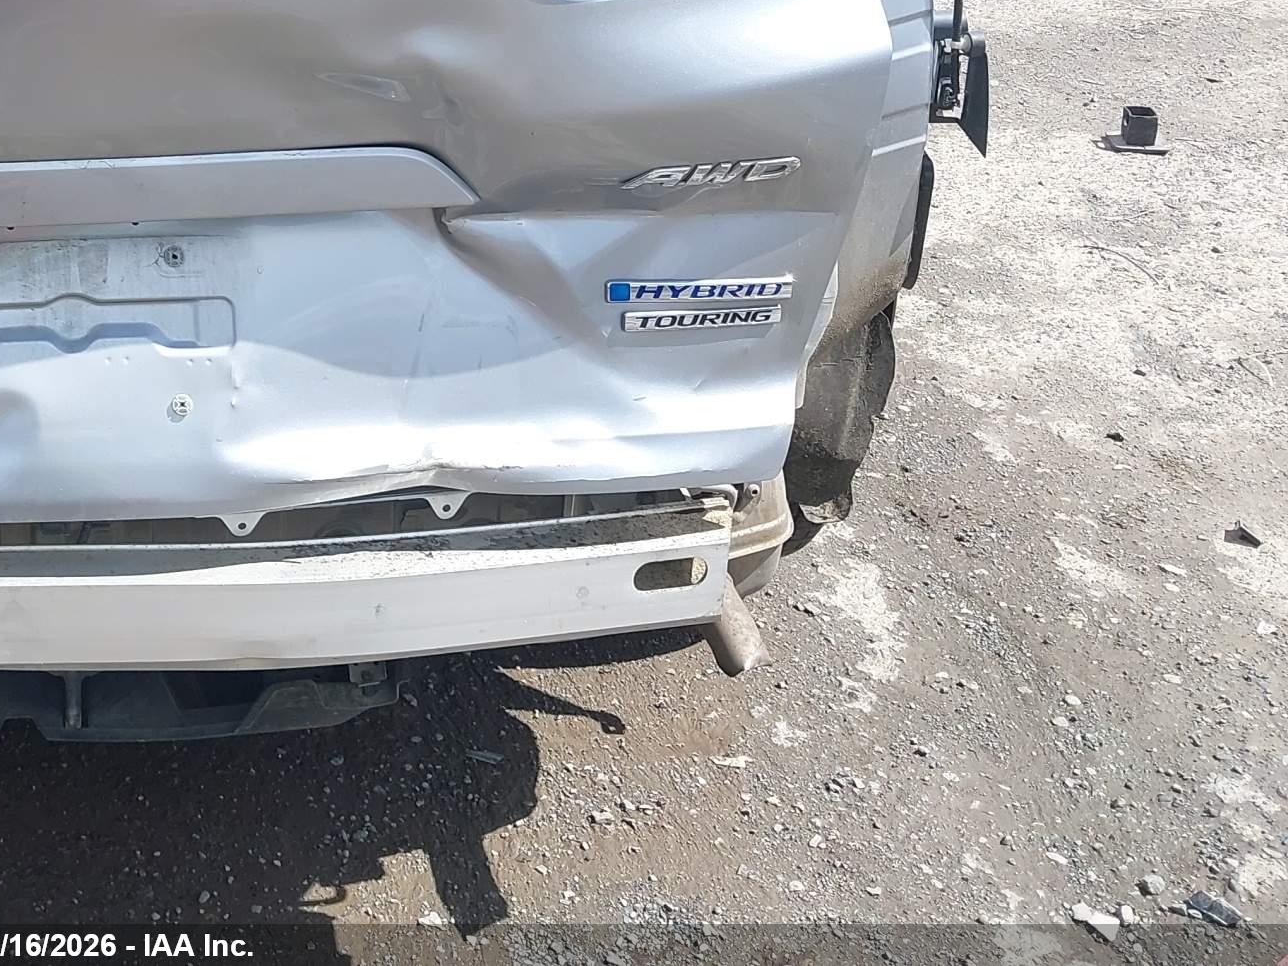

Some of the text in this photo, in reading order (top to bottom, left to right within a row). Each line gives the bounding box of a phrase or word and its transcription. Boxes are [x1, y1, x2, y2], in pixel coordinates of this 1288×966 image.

[620, 156, 801, 190] AWD
[635, 283, 782, 299] HYBRID
[635, 309, 773, 329] TOURING
